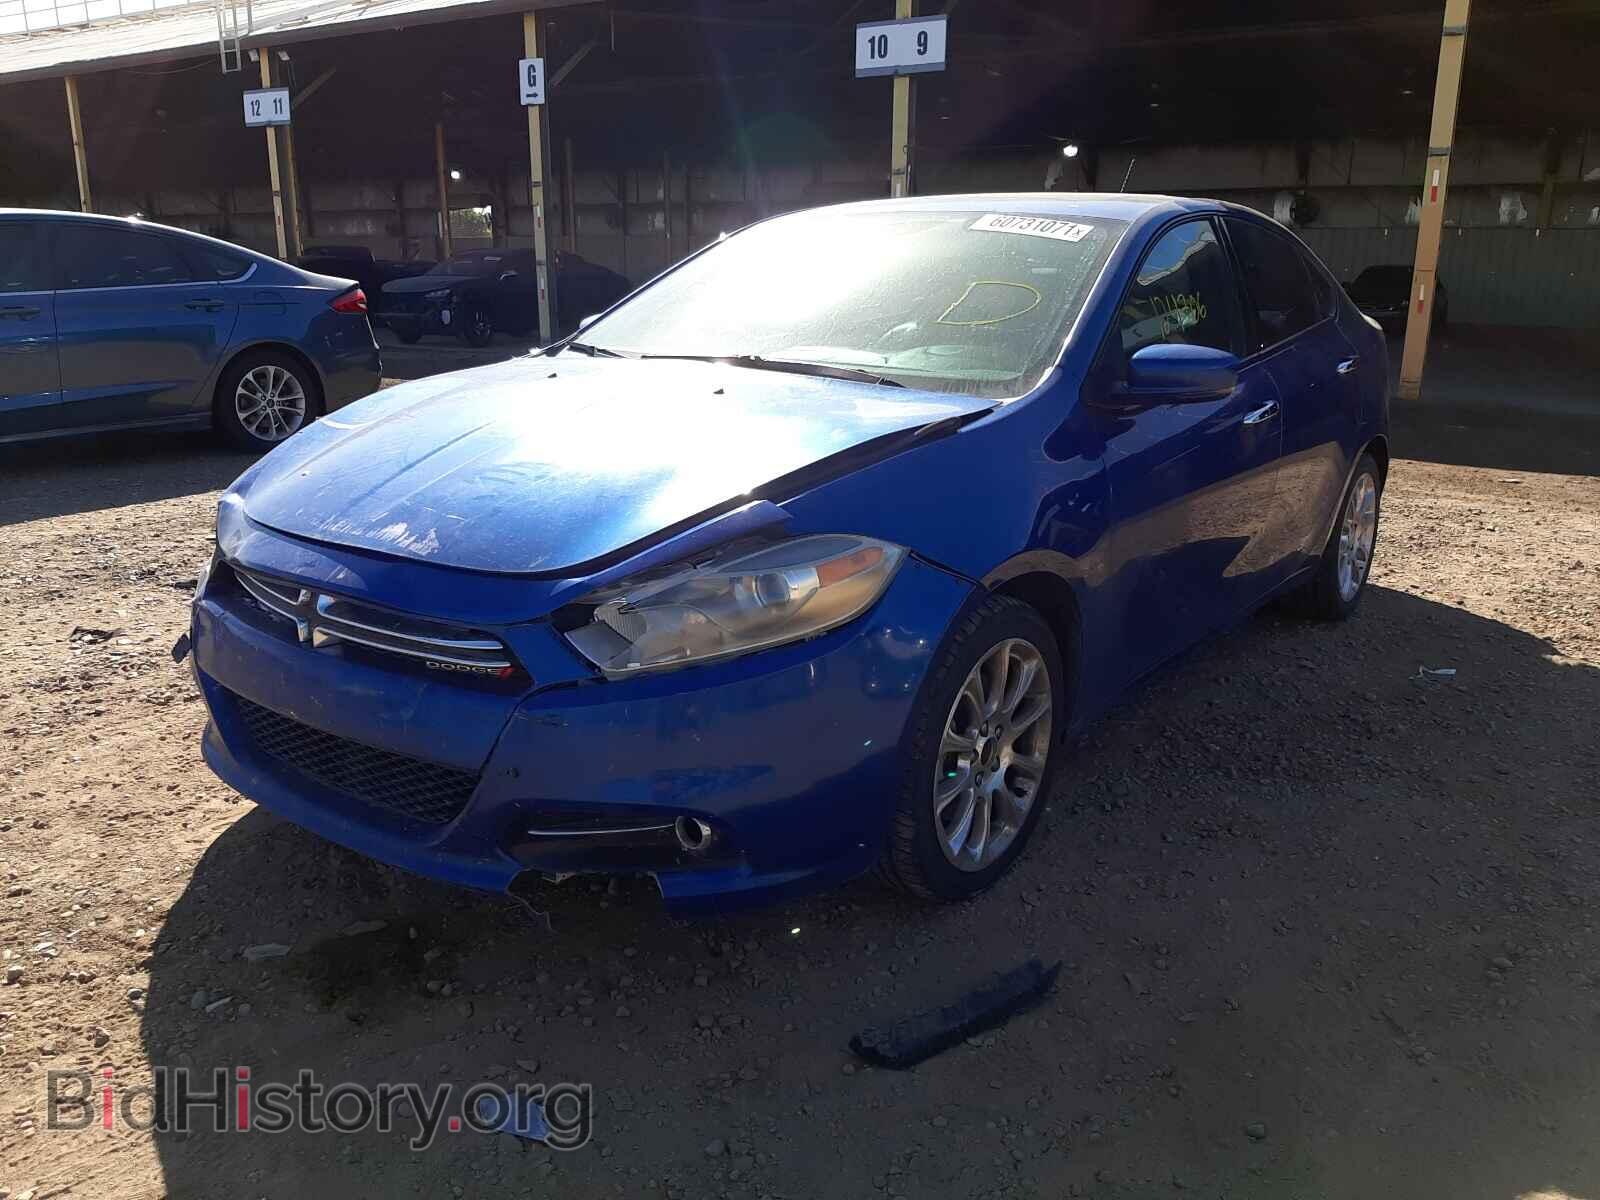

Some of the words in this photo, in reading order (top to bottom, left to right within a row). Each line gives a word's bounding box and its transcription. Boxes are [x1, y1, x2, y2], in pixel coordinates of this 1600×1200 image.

[867, 34, 888, 59] 10
[917, 30, 928, 56] 9
[527, 63, 537, 88] G
[250, 99, 262, 117] 12
[273, 97, 283, 115] 11
[426, 660, 500, 676] DODGE
